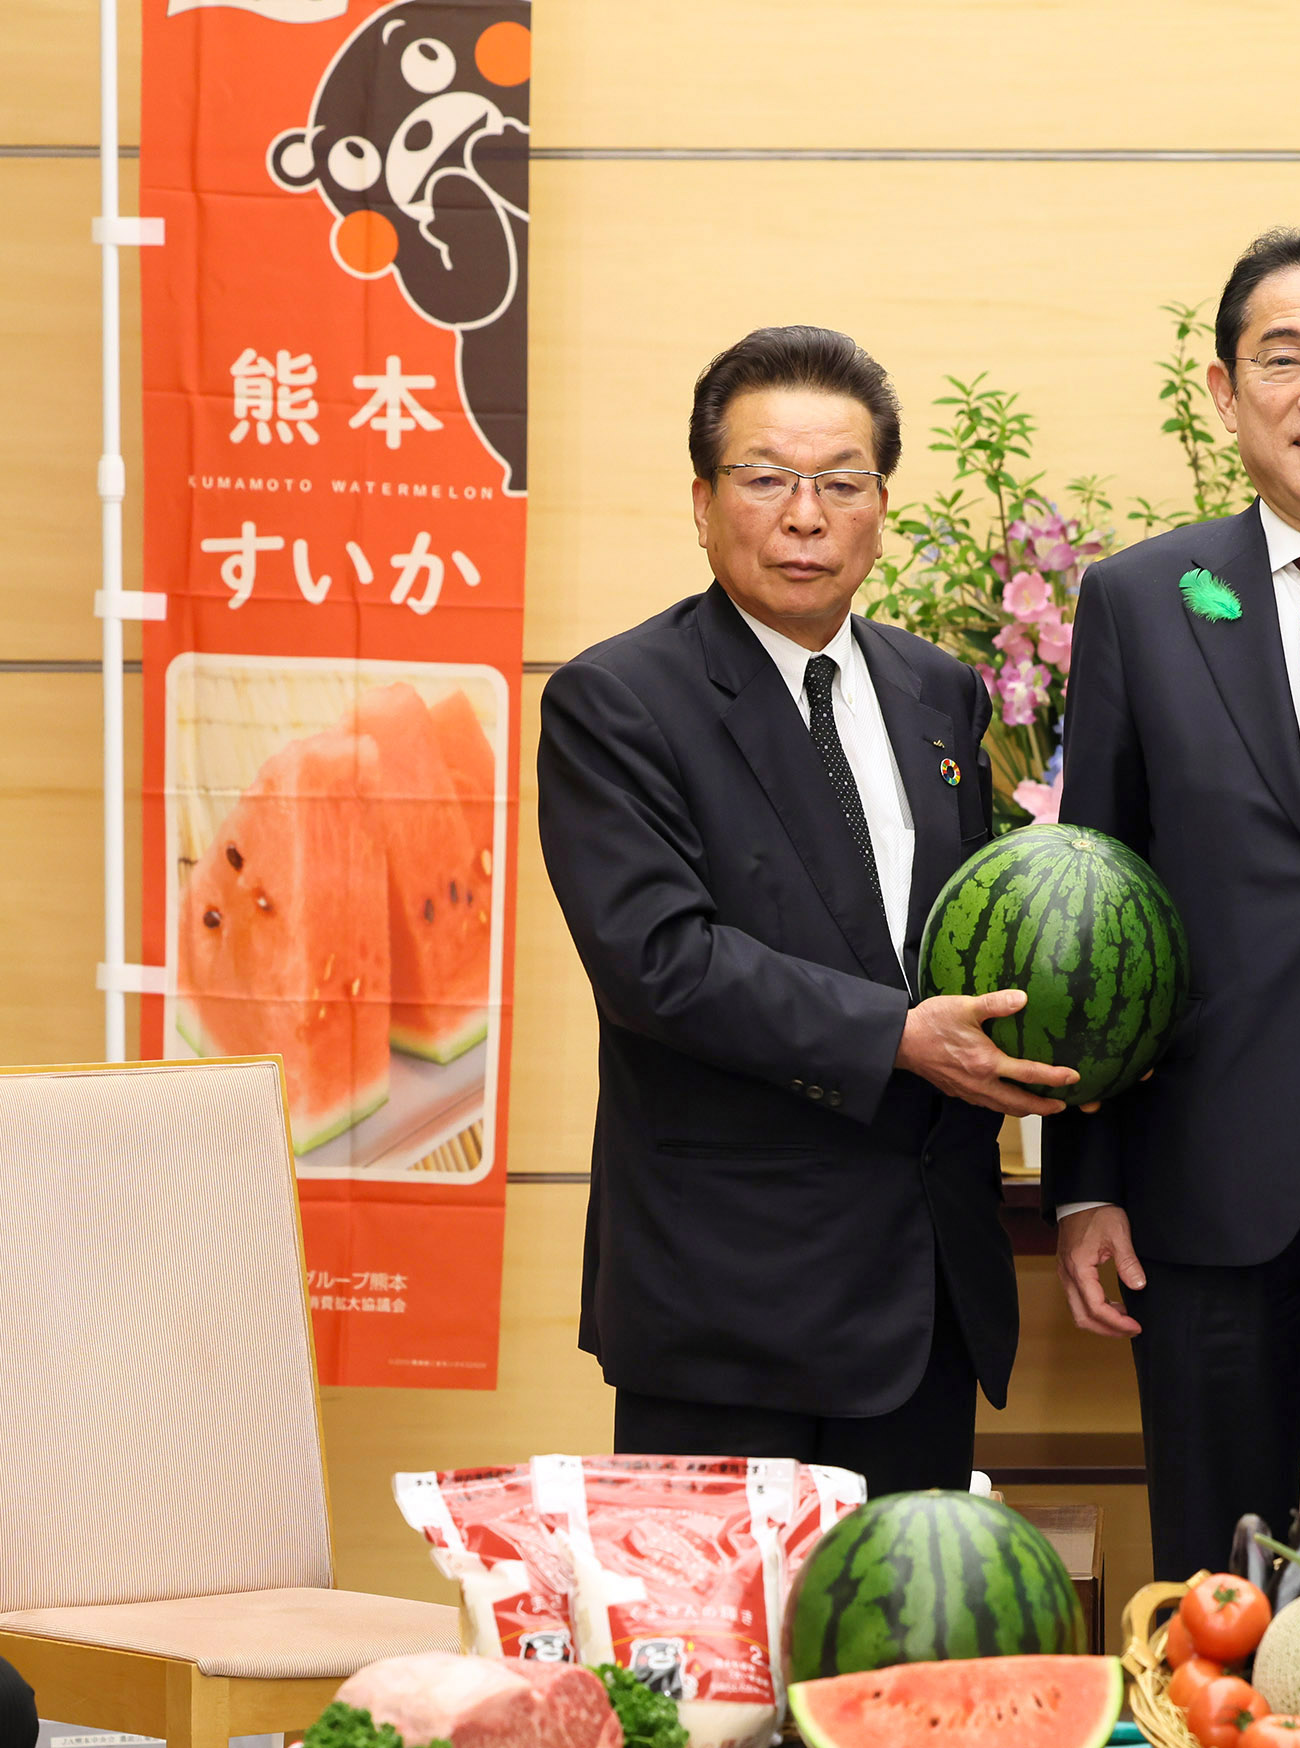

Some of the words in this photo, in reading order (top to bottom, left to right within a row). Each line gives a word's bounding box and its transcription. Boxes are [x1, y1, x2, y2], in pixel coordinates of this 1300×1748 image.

[229, 347, 445, 451] 熊本
[187, 474, 314, 493] KUMAMOTO
[331, 479, 495, 501] WATERMELON
[200, 520, 481, 616] すいか
